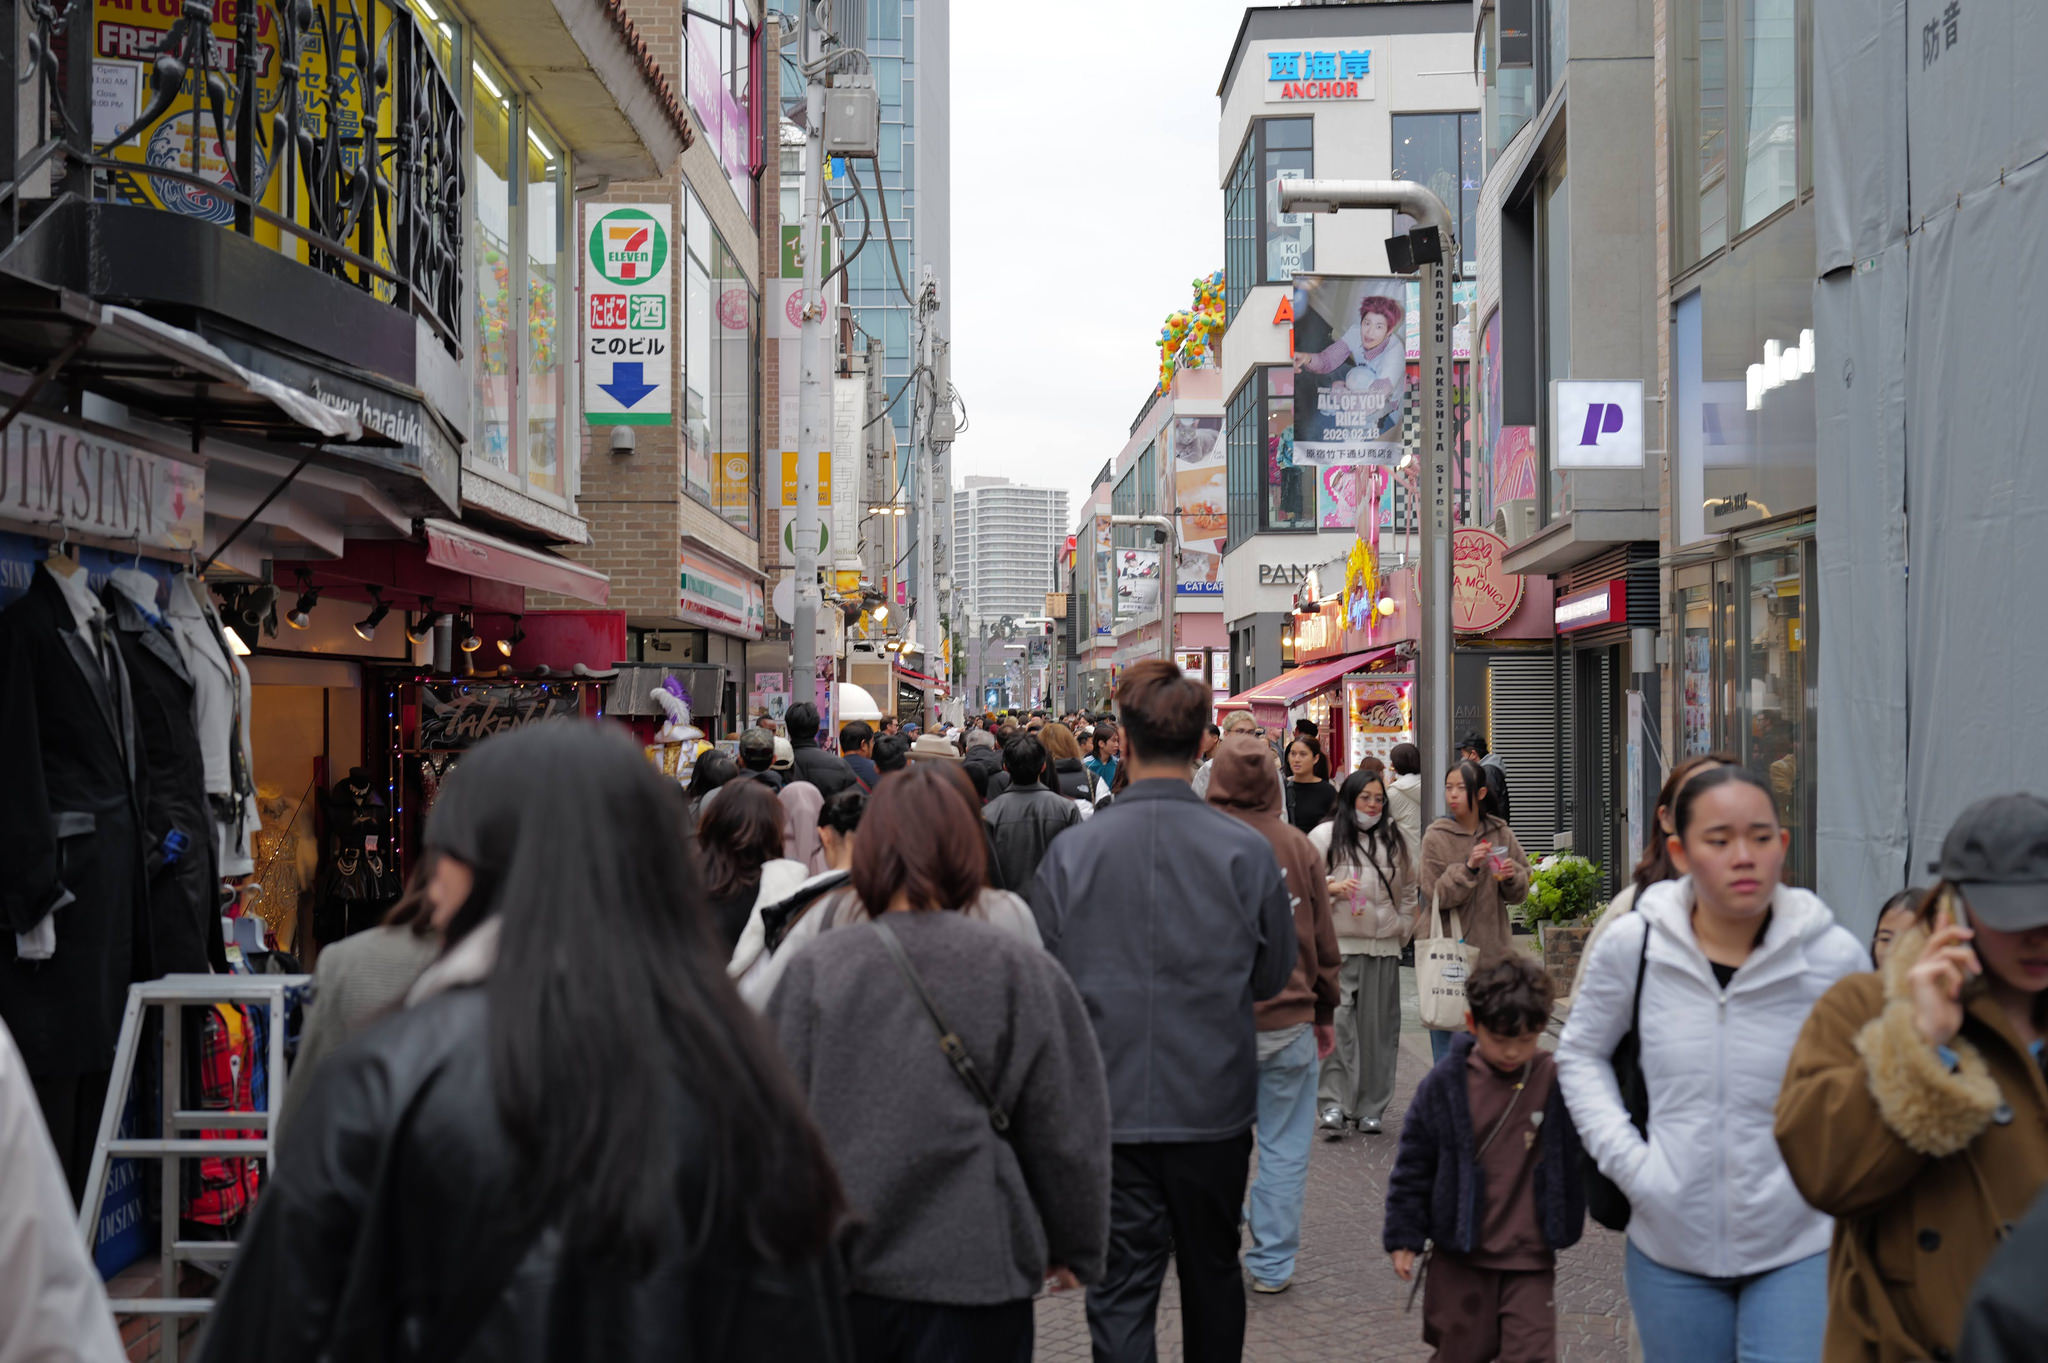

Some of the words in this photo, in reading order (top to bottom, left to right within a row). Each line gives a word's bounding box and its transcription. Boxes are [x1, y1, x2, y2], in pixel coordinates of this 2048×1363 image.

[1923, 0, 1961, 72] 防音
[1268, 50, 1371, 81] 西海岸
[1281, 81, 1358, 99] ANCHOR
[609, 227, 648, 279] 7
[591, 296, 627, 327] たばこ
[631, 295, 663, 327] 酒
[591, 338, 664, 355] このビル
[1317, 394, 1340, 410] ALL
[1342, 394, 1358, 410] OF
[1359, 394, 1385, 410] YOU
[1435, 356, 1444, 451] TAKESHITA
[1335, 410, 1366, 427] RIIZE
[1185, 582, 1204, 591] CAT
[1465, 576, 1507, 612] MONICA
